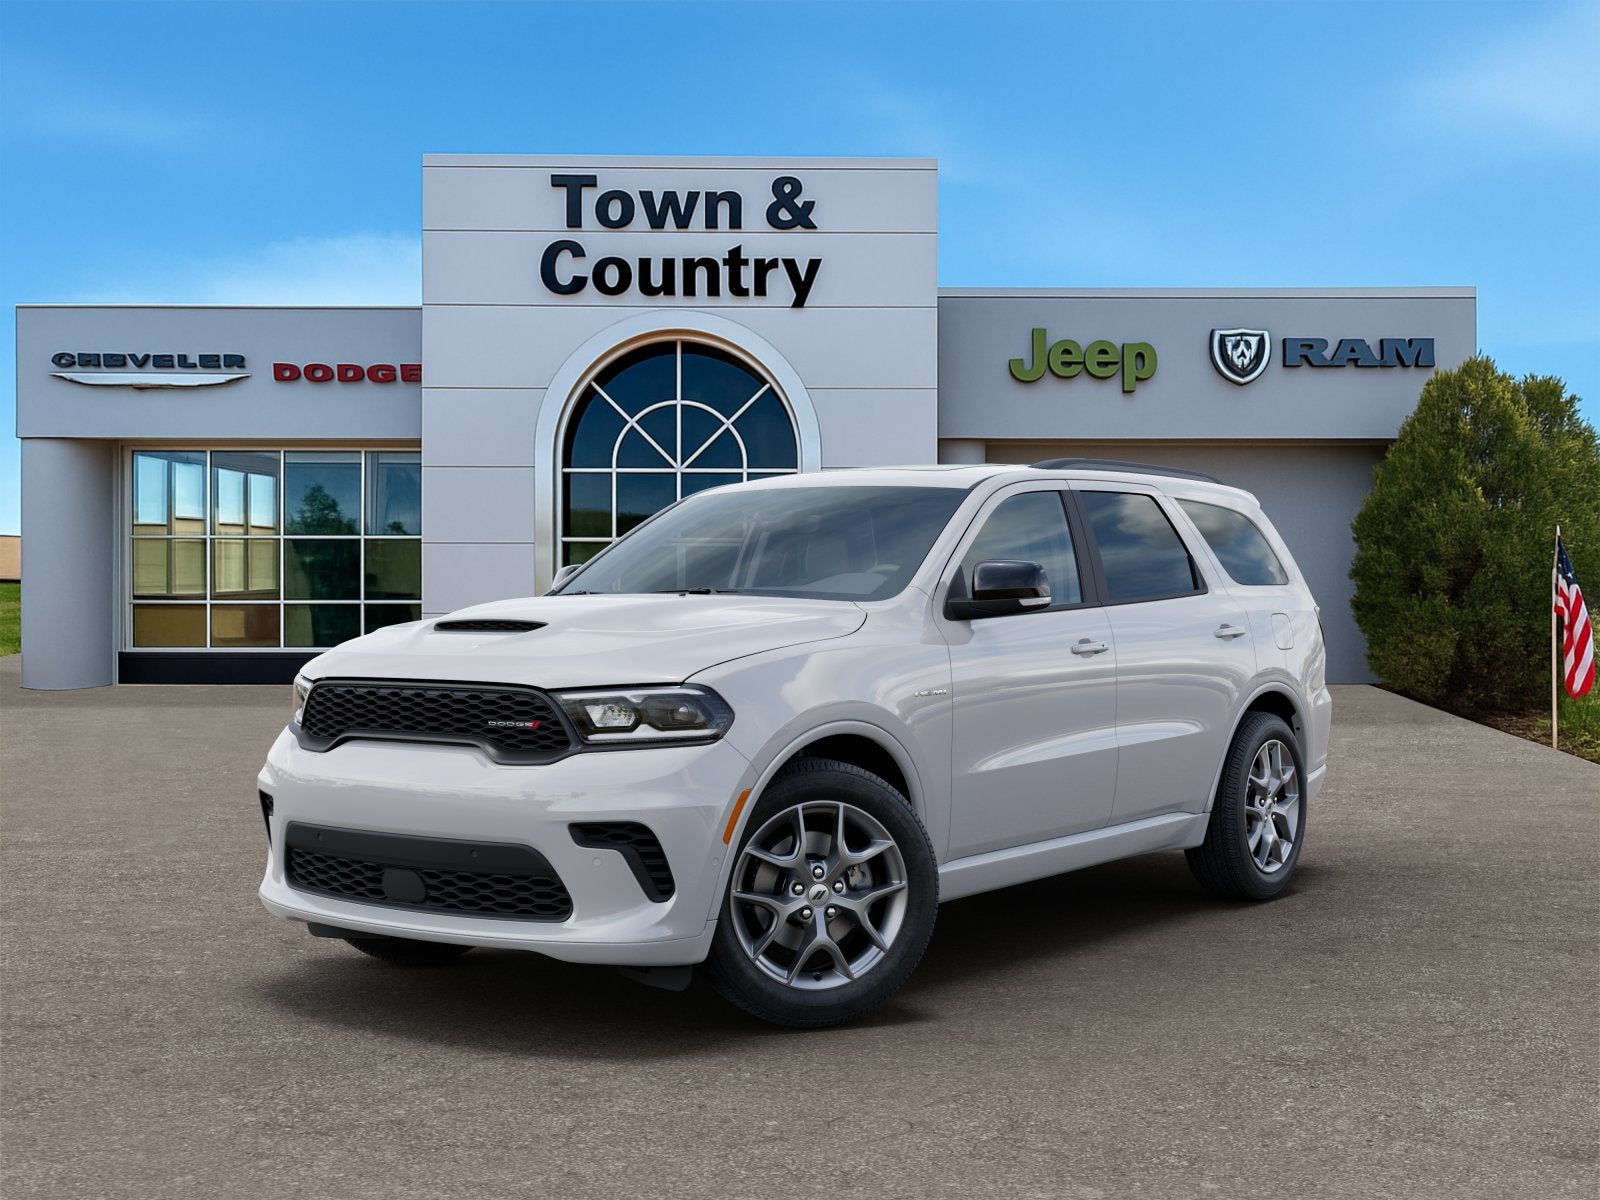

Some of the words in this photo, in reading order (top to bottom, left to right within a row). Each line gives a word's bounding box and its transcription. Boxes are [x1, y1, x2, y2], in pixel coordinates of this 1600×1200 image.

[550, 174, 742, 230] Town
[765, 176, 818, 230] &
[540, 239, 822, 309] Country
[273, 363, 422, 383] DODGE
[1009, 327, 1158, 393] Jeep
[1282, 337, 1436, 368] RAM
[487, 720, 534, 728] DODGE
